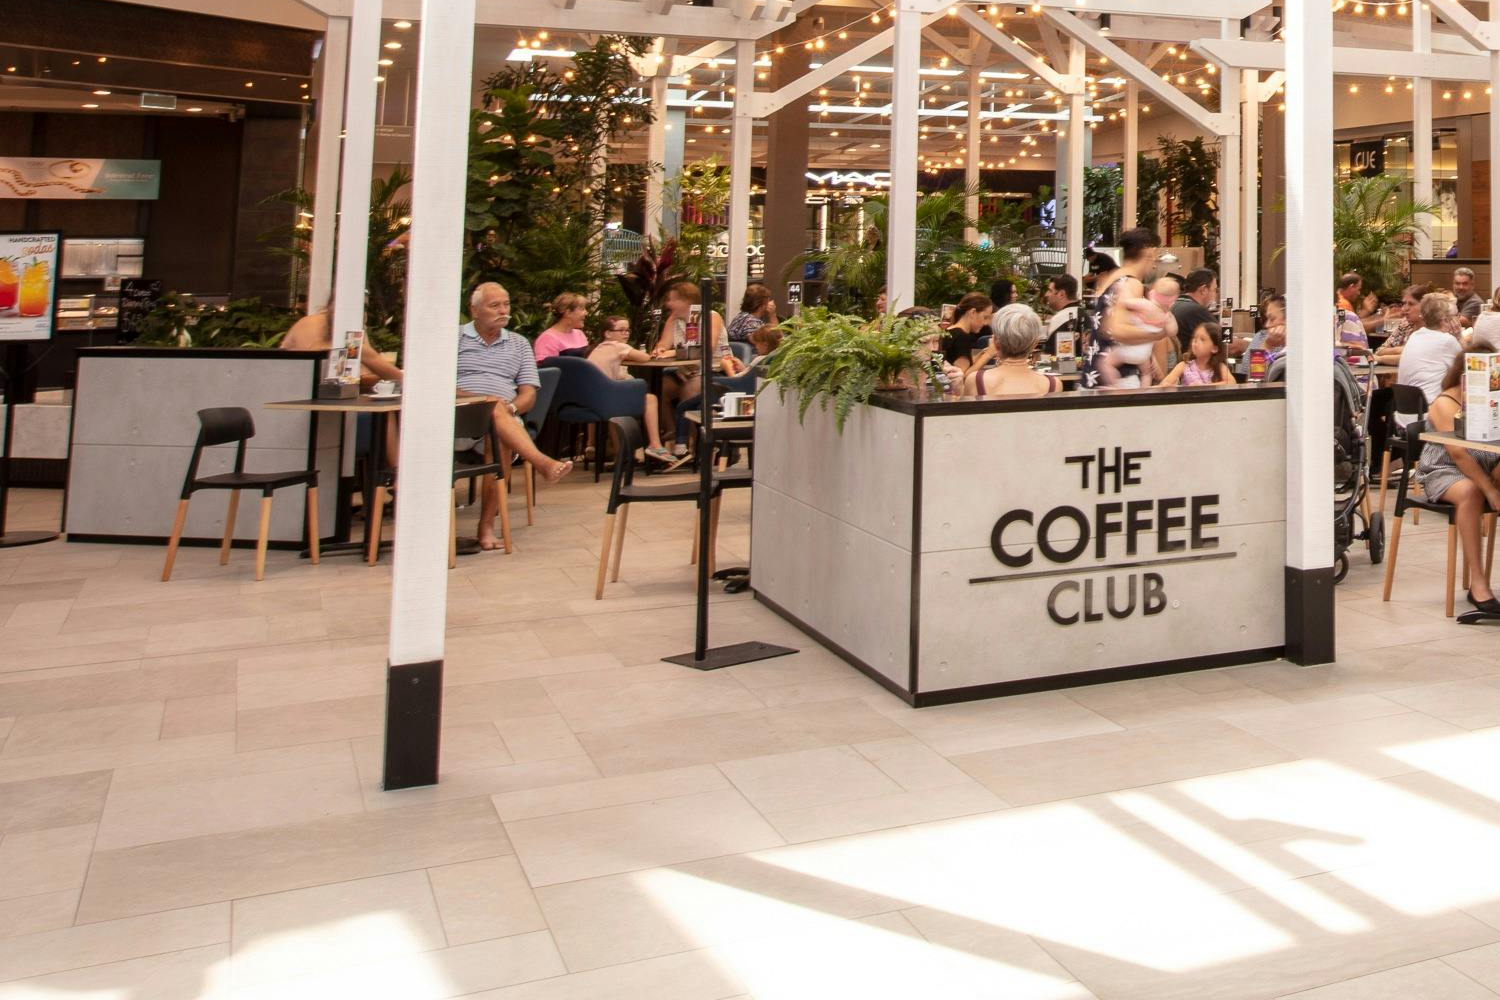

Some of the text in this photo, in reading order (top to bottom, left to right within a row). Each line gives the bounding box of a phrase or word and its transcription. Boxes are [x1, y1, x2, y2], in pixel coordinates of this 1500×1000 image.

[1355, 150, 1376, 169] CUE
[1065, 446, 1152, 494] THE
[990, 494, 1220, 568] COFFEE
[1047, 572, 1168, 626] CLUB
